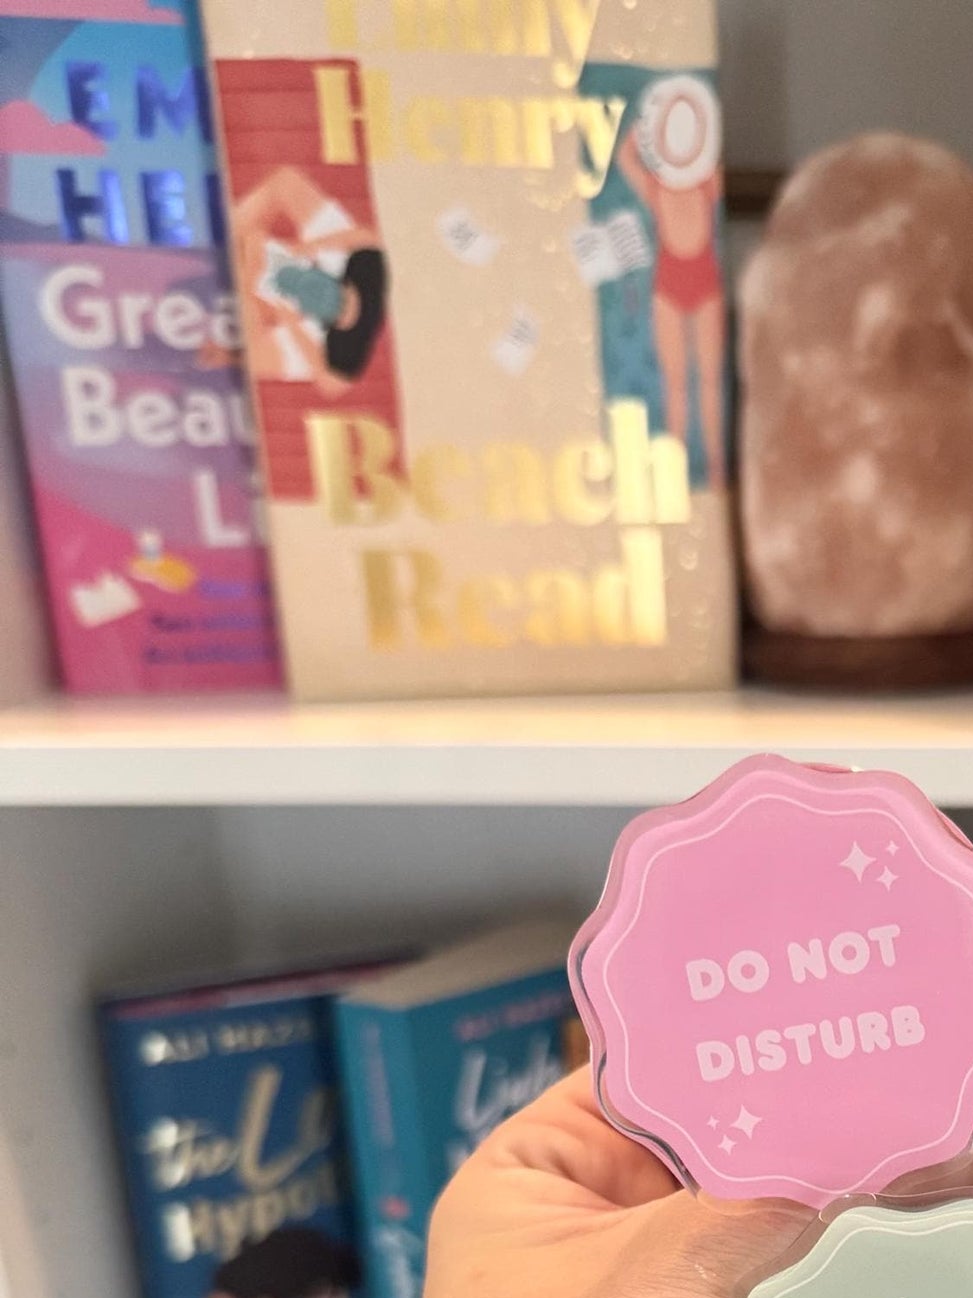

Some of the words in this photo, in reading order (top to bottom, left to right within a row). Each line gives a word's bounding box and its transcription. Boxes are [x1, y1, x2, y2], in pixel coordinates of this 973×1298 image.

[314, 66, 626, 198] Henry
[303, 397, 692, 526] Beach
[360, 526, 668, 653] Read
[686, 949, 771, 1001] DO
[786, 923, 900, 984] NOT
[695, 1005, 926, 1083] DISTURB
